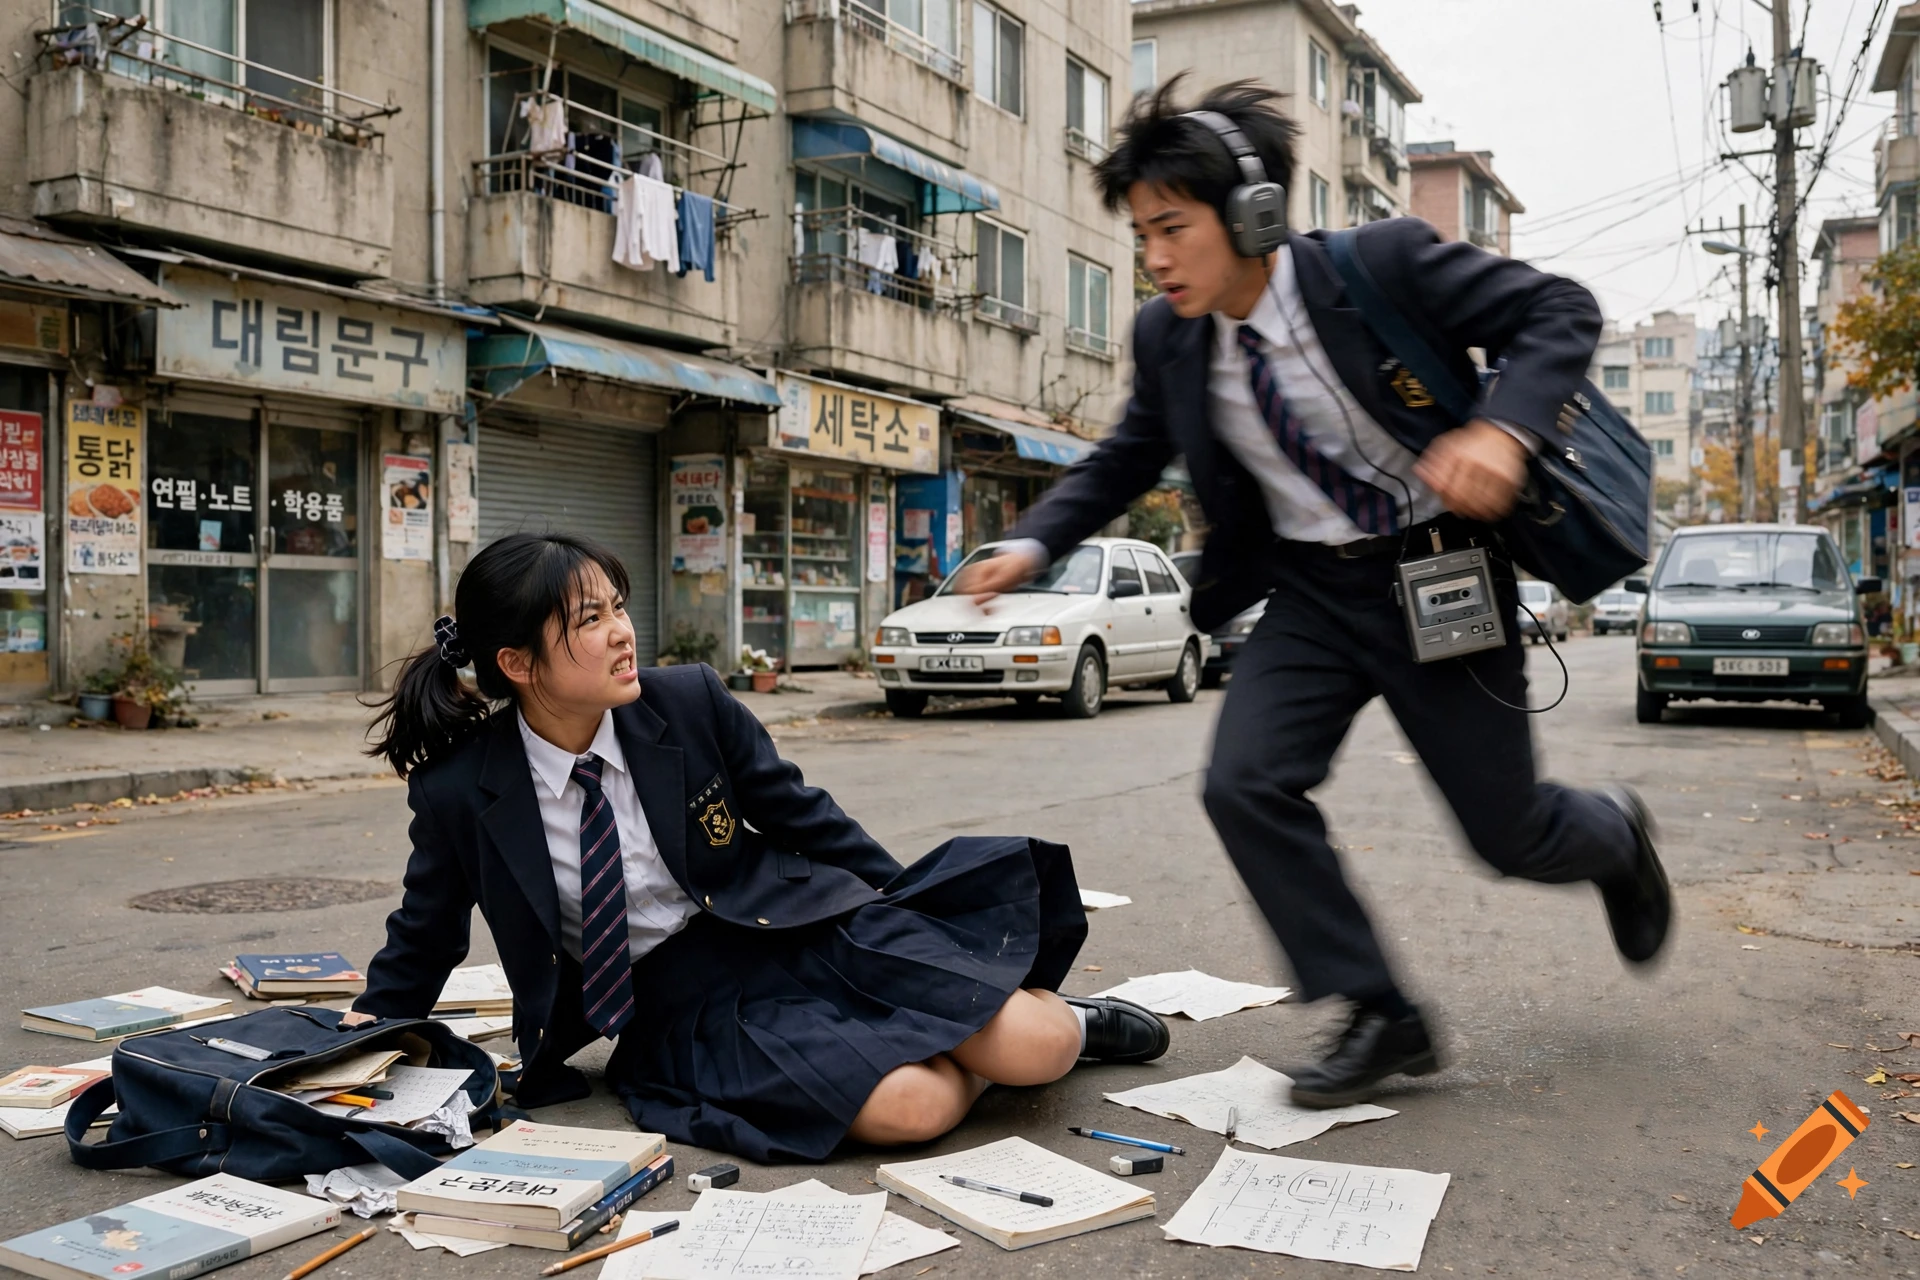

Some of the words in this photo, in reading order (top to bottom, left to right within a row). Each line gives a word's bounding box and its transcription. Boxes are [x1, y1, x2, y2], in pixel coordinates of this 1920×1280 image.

[212, 298, 429, 388] 대림문구
[814, 394, 909, 453] 세탁소
[75, 434, 135, 480] 통닭
